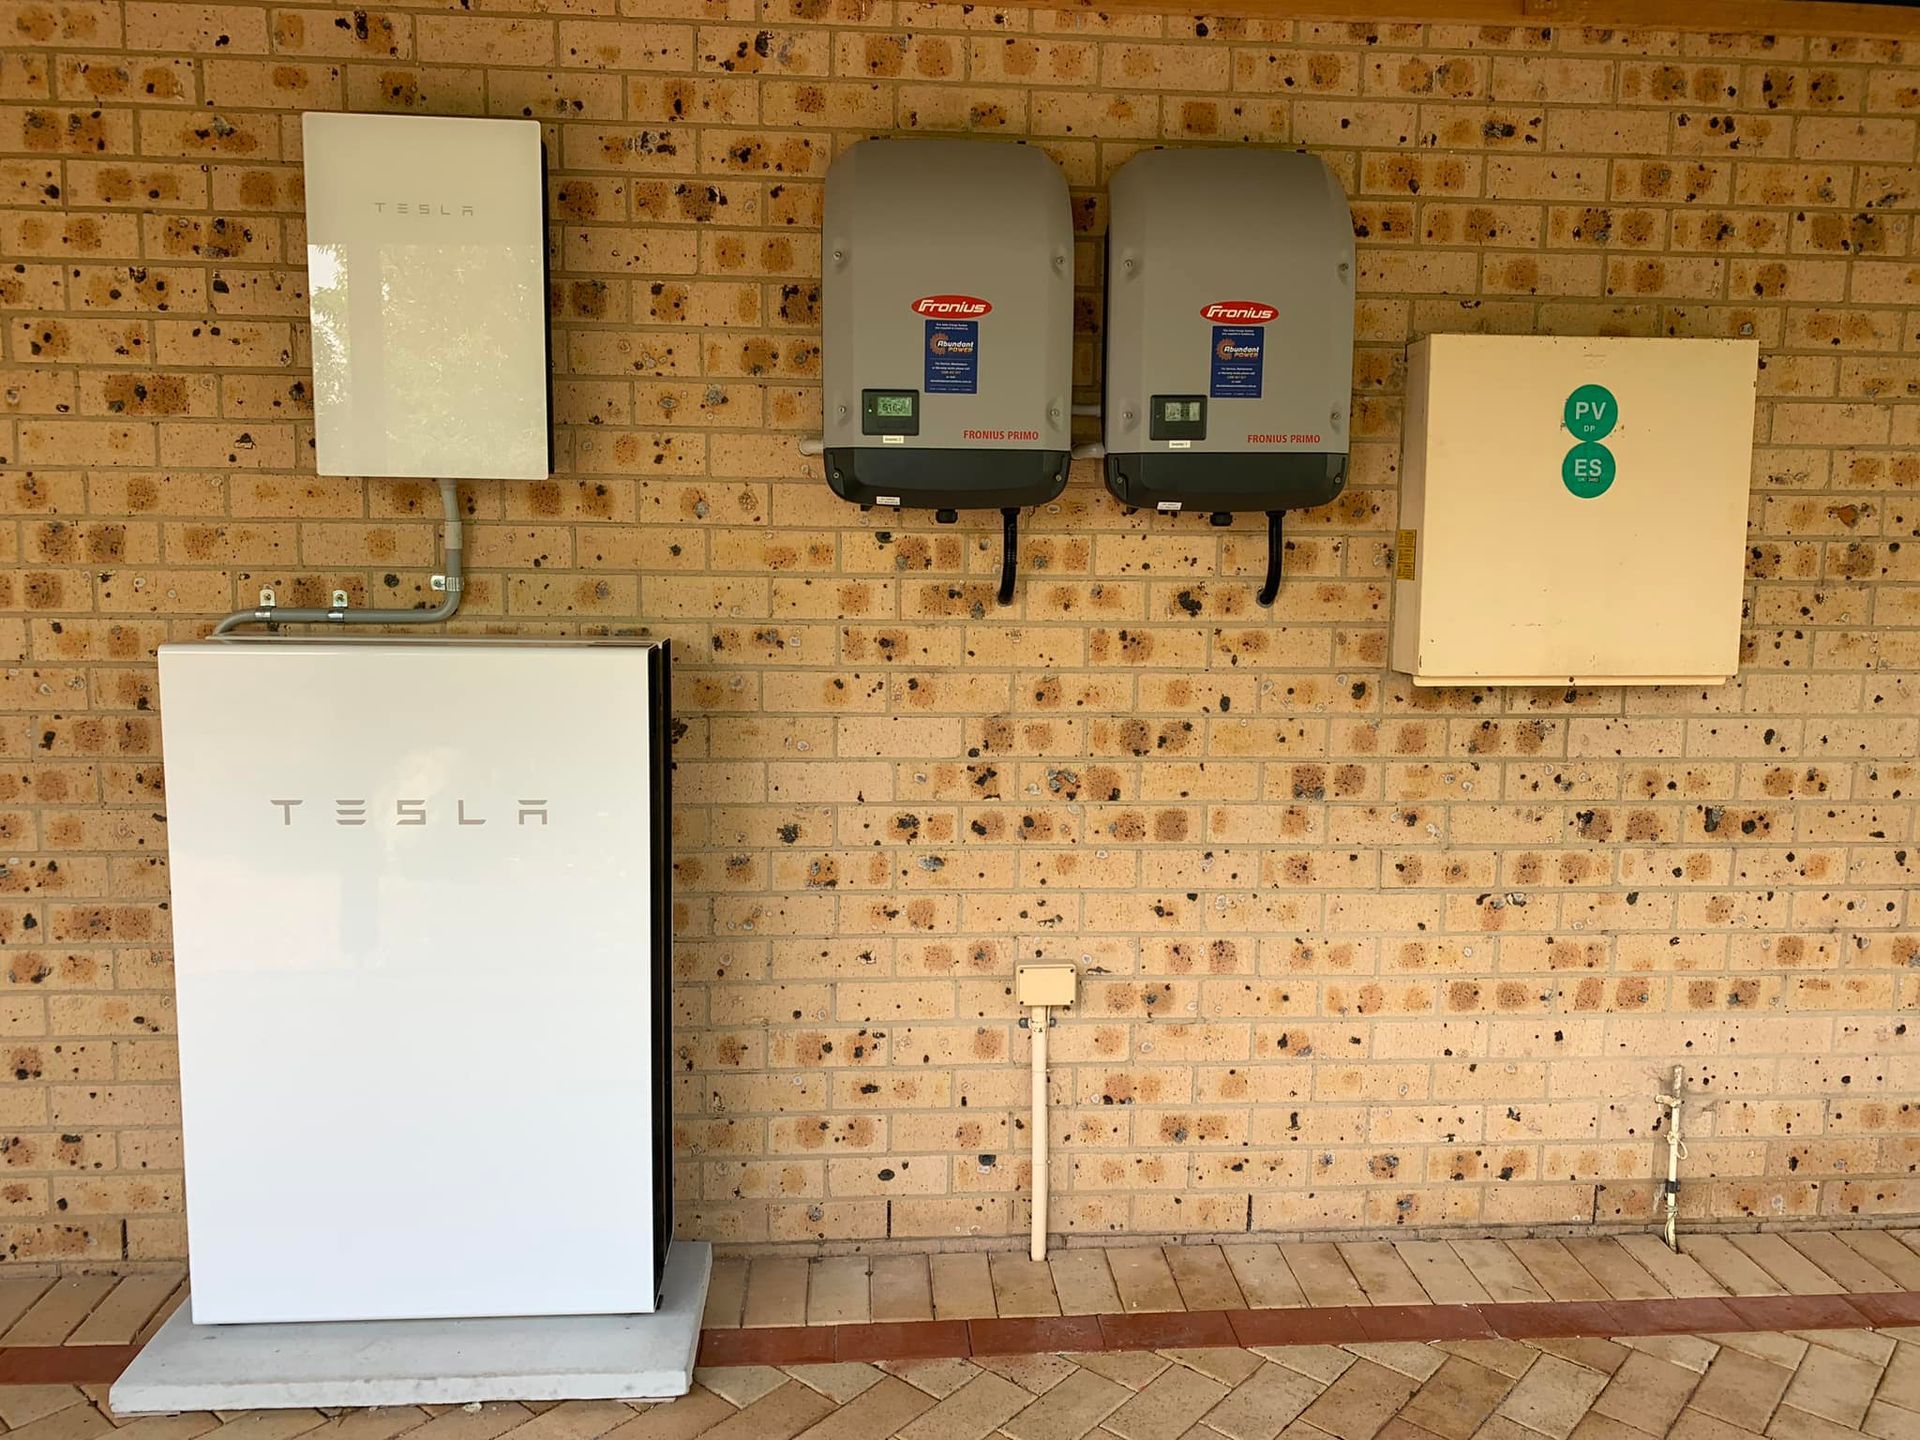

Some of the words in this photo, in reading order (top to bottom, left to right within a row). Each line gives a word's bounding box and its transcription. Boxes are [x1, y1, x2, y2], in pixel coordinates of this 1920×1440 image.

[373, 202, 474, 216] TESLA
[918, 299, 986, 314] Fronius
[1206, 305, 1274, 319] Fronius
[937, 340, 974, 348] Abundant
[1224, 346, 1260, 354] Abundant
[1575, 401, 1607, 420] PV
[963, 430, 1005, 440] FRONIUS
[1007, 430, 1040, 441] PRIMO
[1247, 434, 1288, 444] FRONIUS
[1290, 434, 1321, 444] PRIMO
[1574, 458, 1603, 477] ES
[270, 799, 549, 826] TESLA
